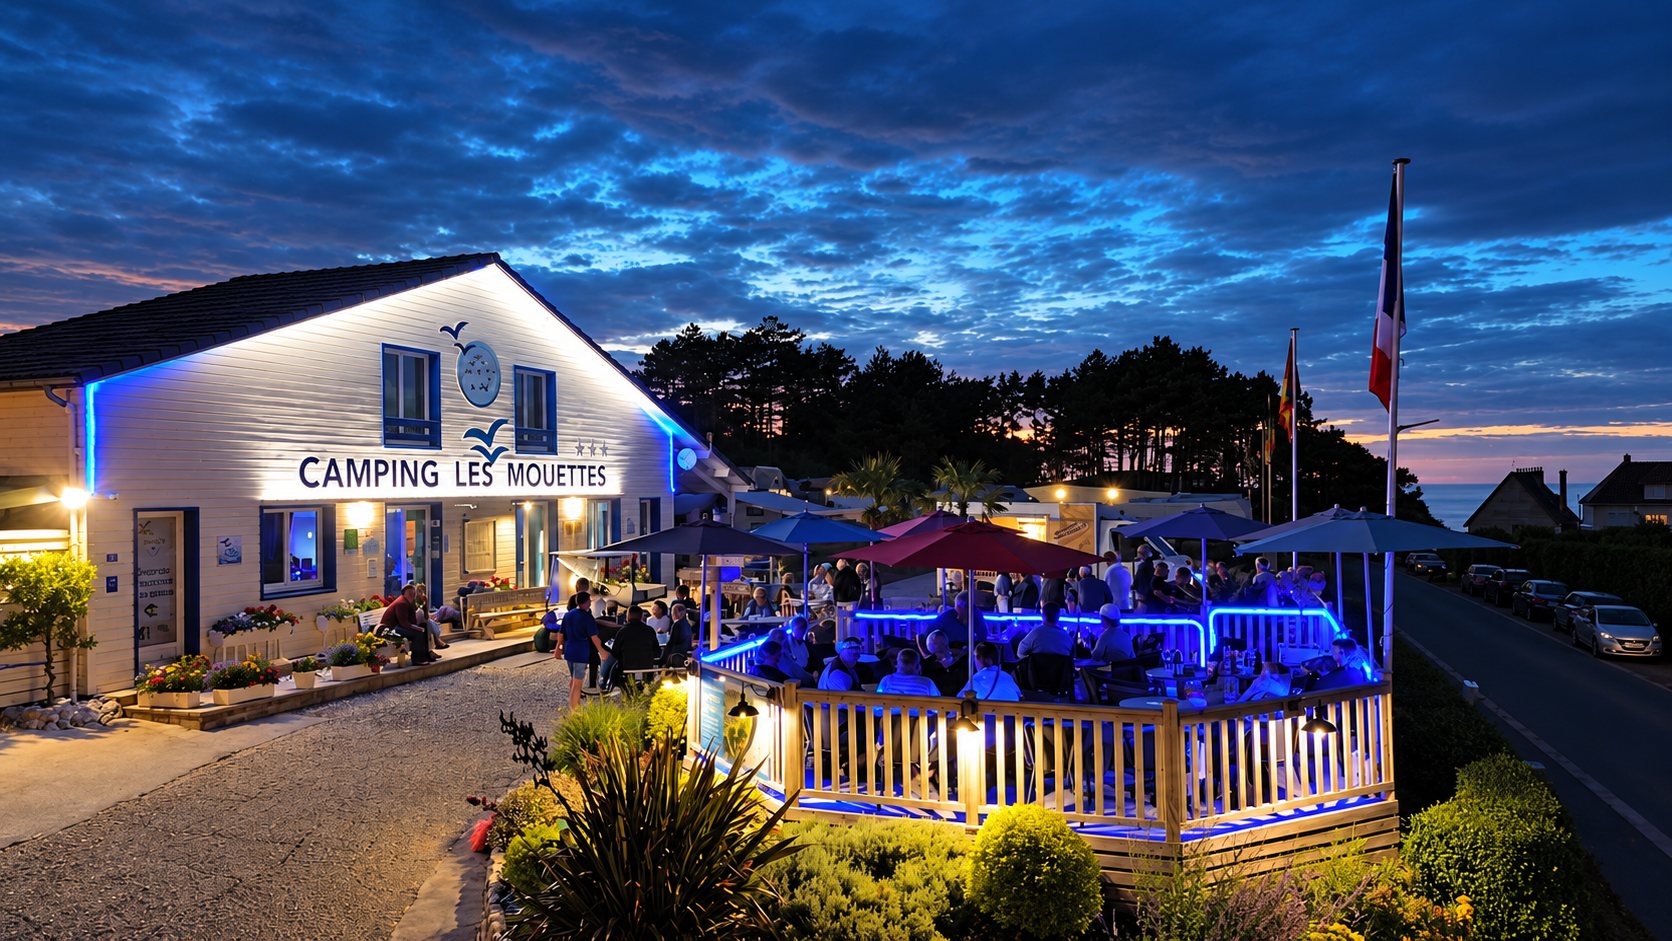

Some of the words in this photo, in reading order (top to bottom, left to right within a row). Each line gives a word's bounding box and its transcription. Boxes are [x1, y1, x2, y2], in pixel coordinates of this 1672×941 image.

[299, 456, 438, 488] CAMPING
[455, 461, 493, 487] LES
[508, 463, 606, 487] MOUETTES
